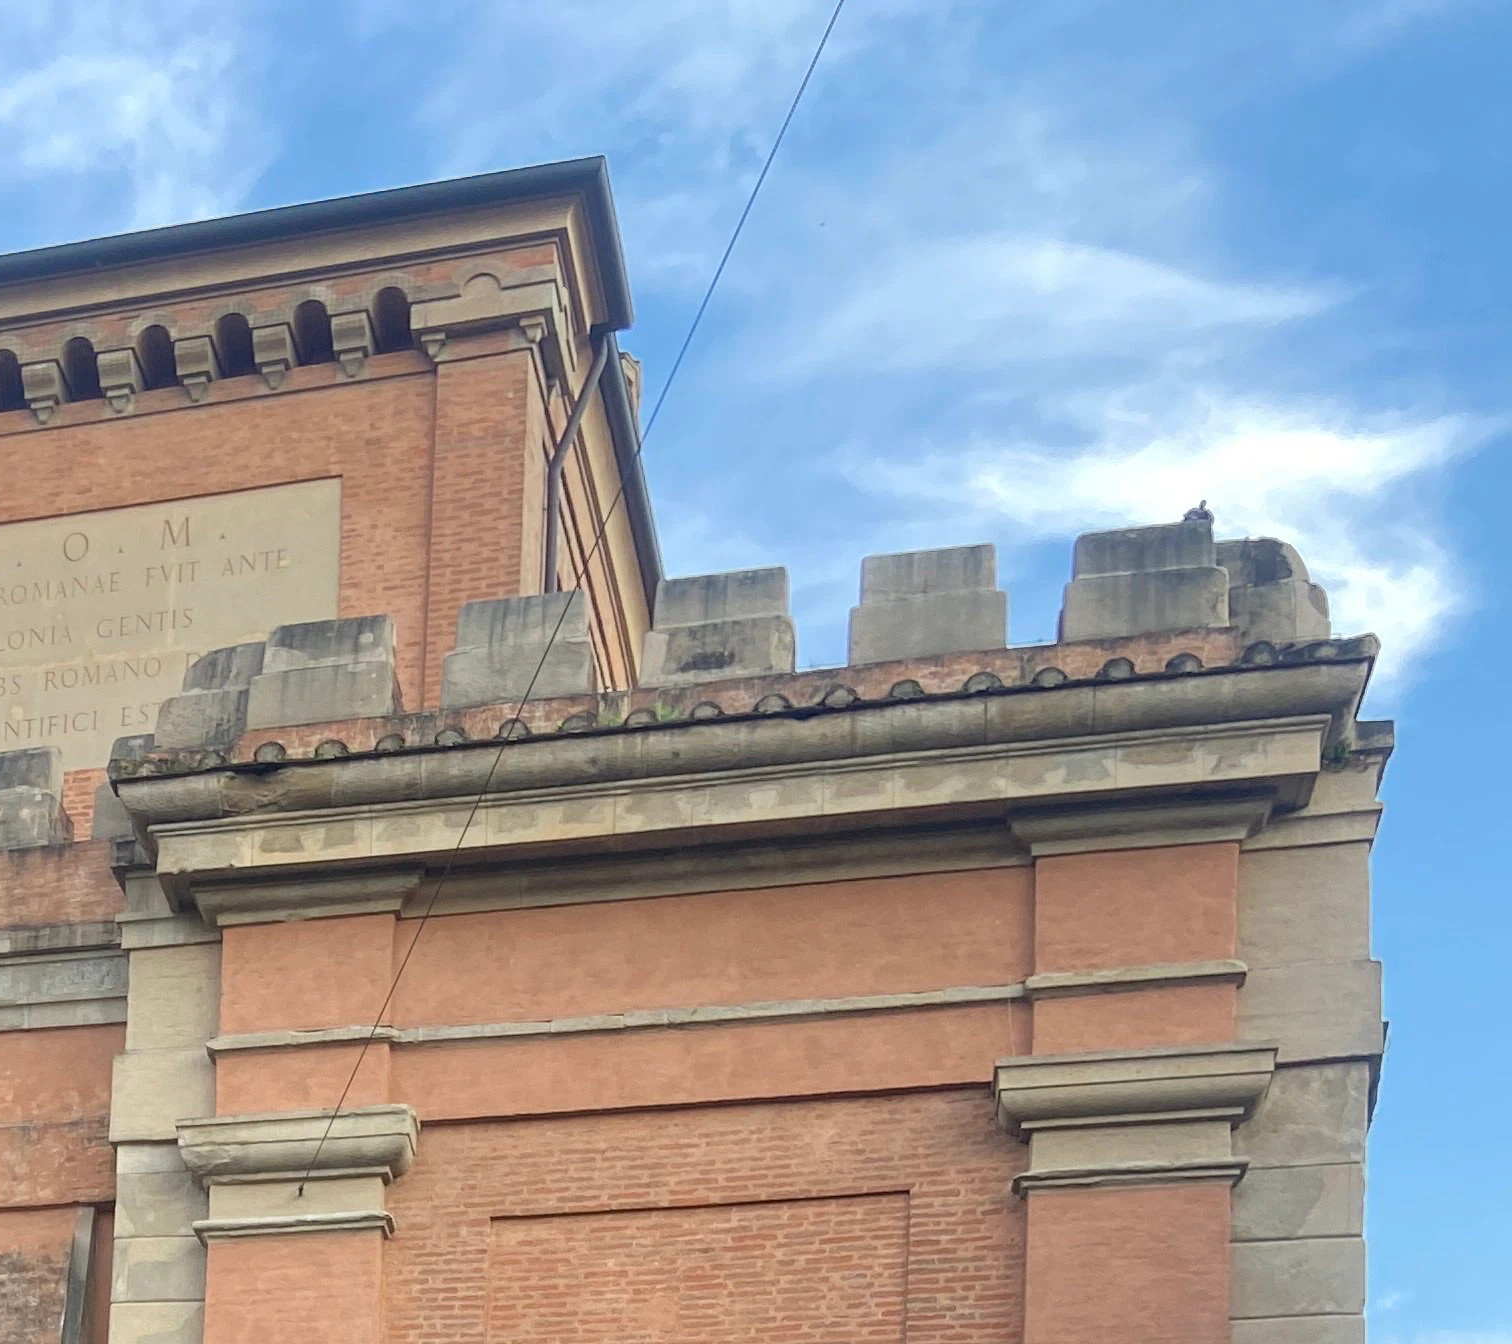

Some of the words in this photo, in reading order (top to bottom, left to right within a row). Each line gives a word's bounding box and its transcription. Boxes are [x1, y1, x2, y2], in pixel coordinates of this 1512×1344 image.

[221, 547, 289, 575] ANTE
[96, 608, 194, 640] GENTIS
[43, 656, 162, 690] ROMANO
